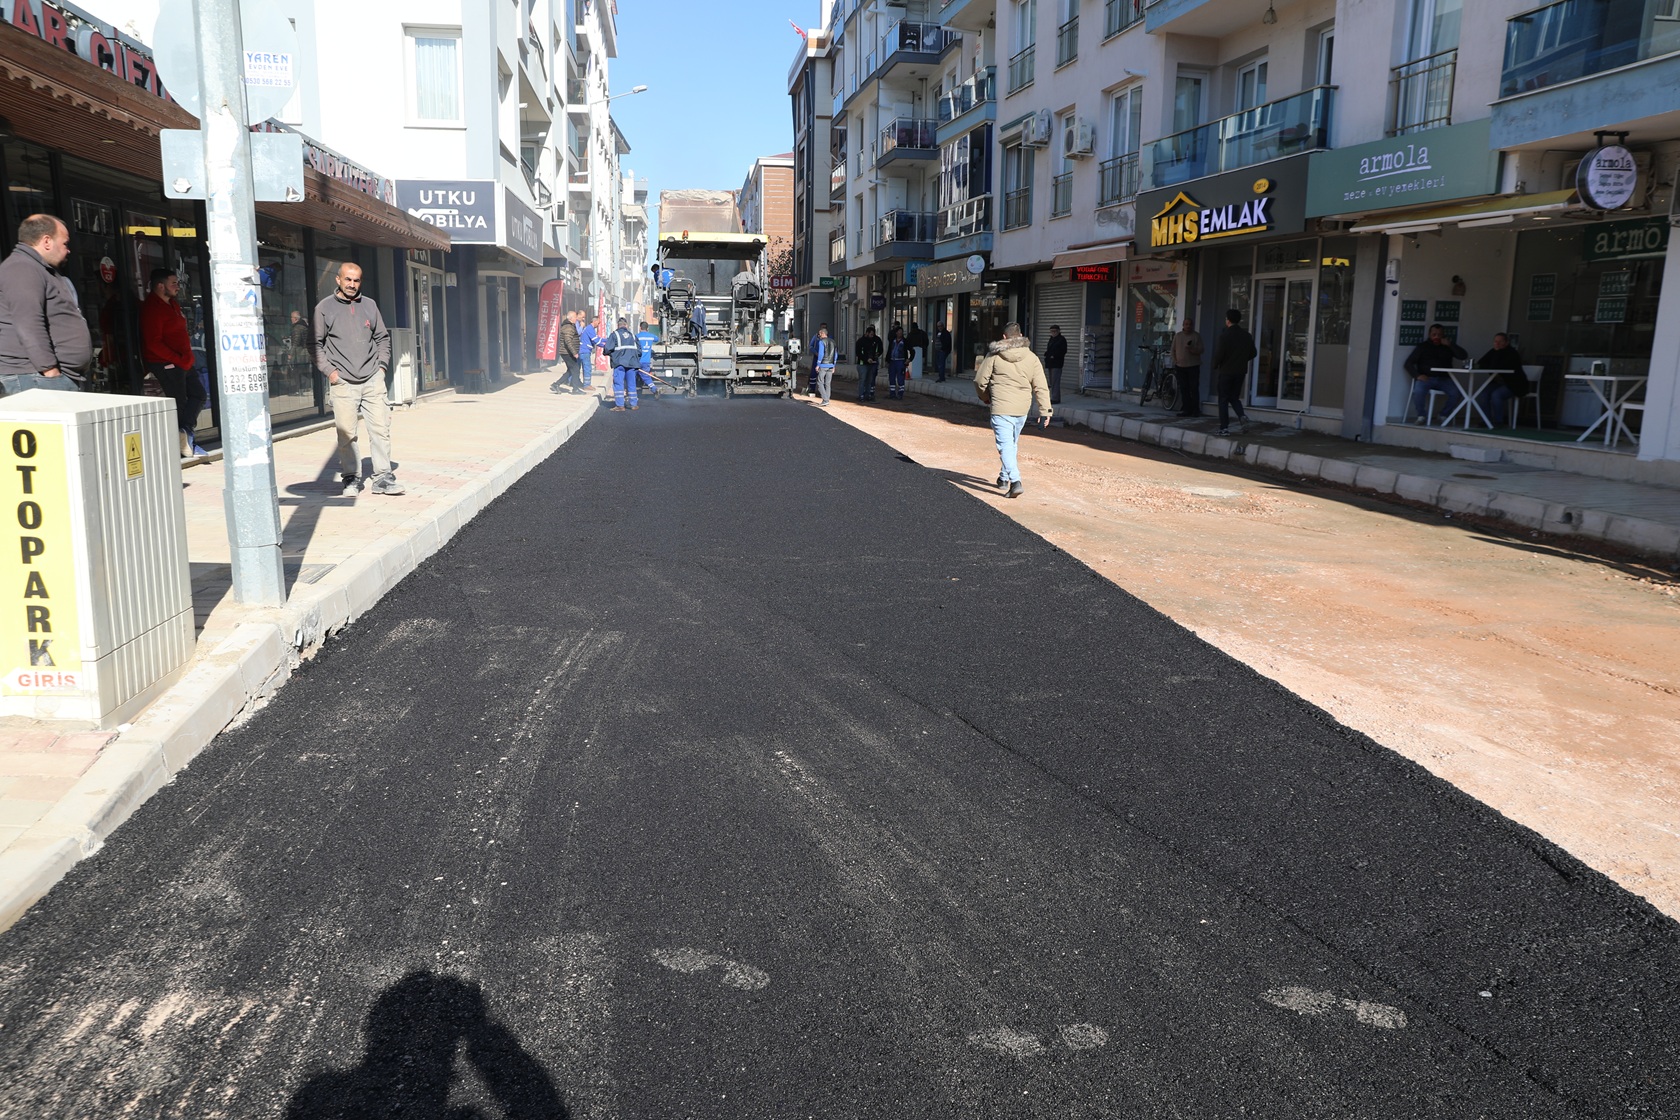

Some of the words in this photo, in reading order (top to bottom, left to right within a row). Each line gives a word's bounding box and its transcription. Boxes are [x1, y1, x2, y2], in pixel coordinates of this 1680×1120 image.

[247, 53, 288, 64] YAREN
[1360, 145, 1429, 175] armola
[1596, 157, 1632, 168] armola
[1344, 190, 1366, 201] meze
[1389, 175, 1445, 197] yemekleri
[419, 190, 476, 205] UTKU
[1151, 211, 1199, 247] MHS
[1200, 197, 1268, 234] EMLAK
[1594, 226, 1666, 254] armo
[1076, 265, 1110, 273] VODAFONE
[773, 274, 793, 287] BİM
[231, 384, 246, 393] 545
[11, 429, 56, 666] OTOPARK
